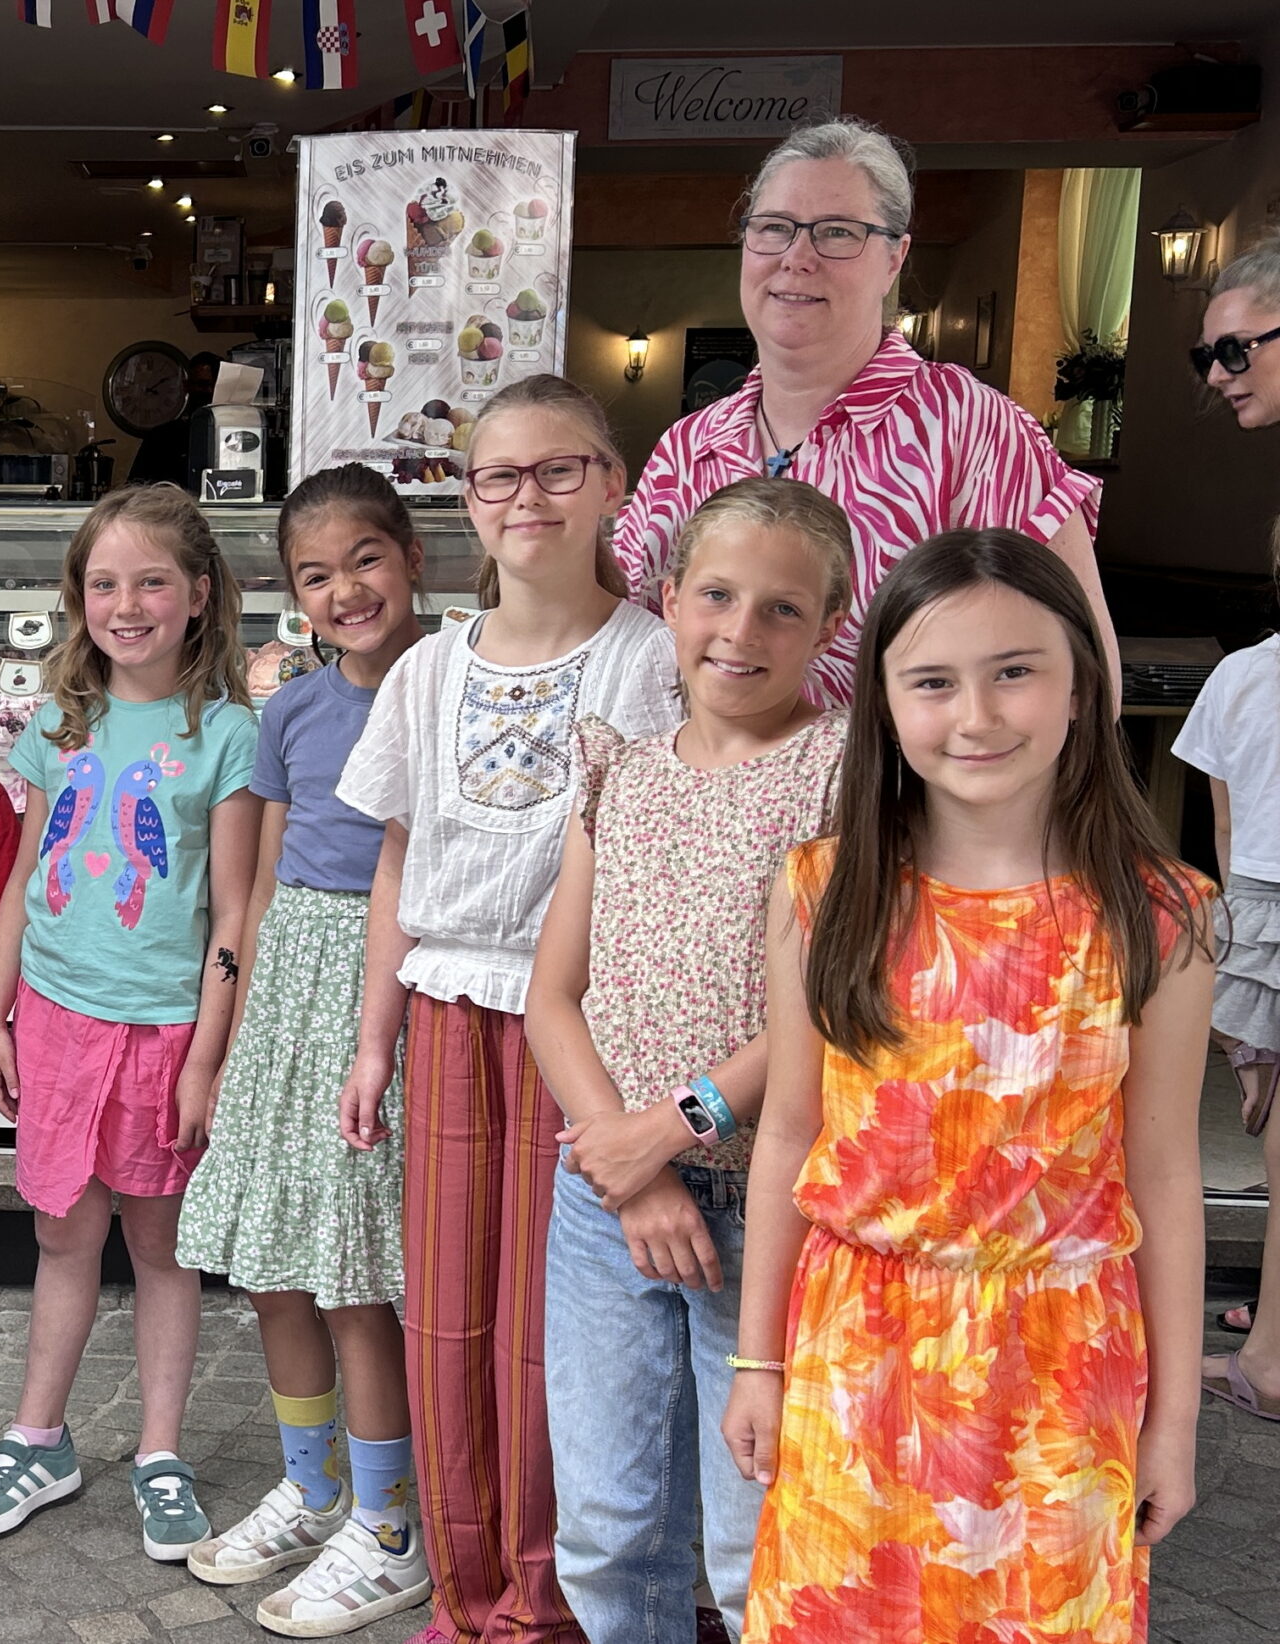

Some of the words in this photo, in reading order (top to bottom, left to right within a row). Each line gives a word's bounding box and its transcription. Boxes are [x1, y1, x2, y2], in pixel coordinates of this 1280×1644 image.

[634, 66, 809, 122] Welcome
[335, 159, 366, 182] EIS
[371, 149, 414, 170] ZUM
[421, 145, 543, 179] MITNEHMEN
